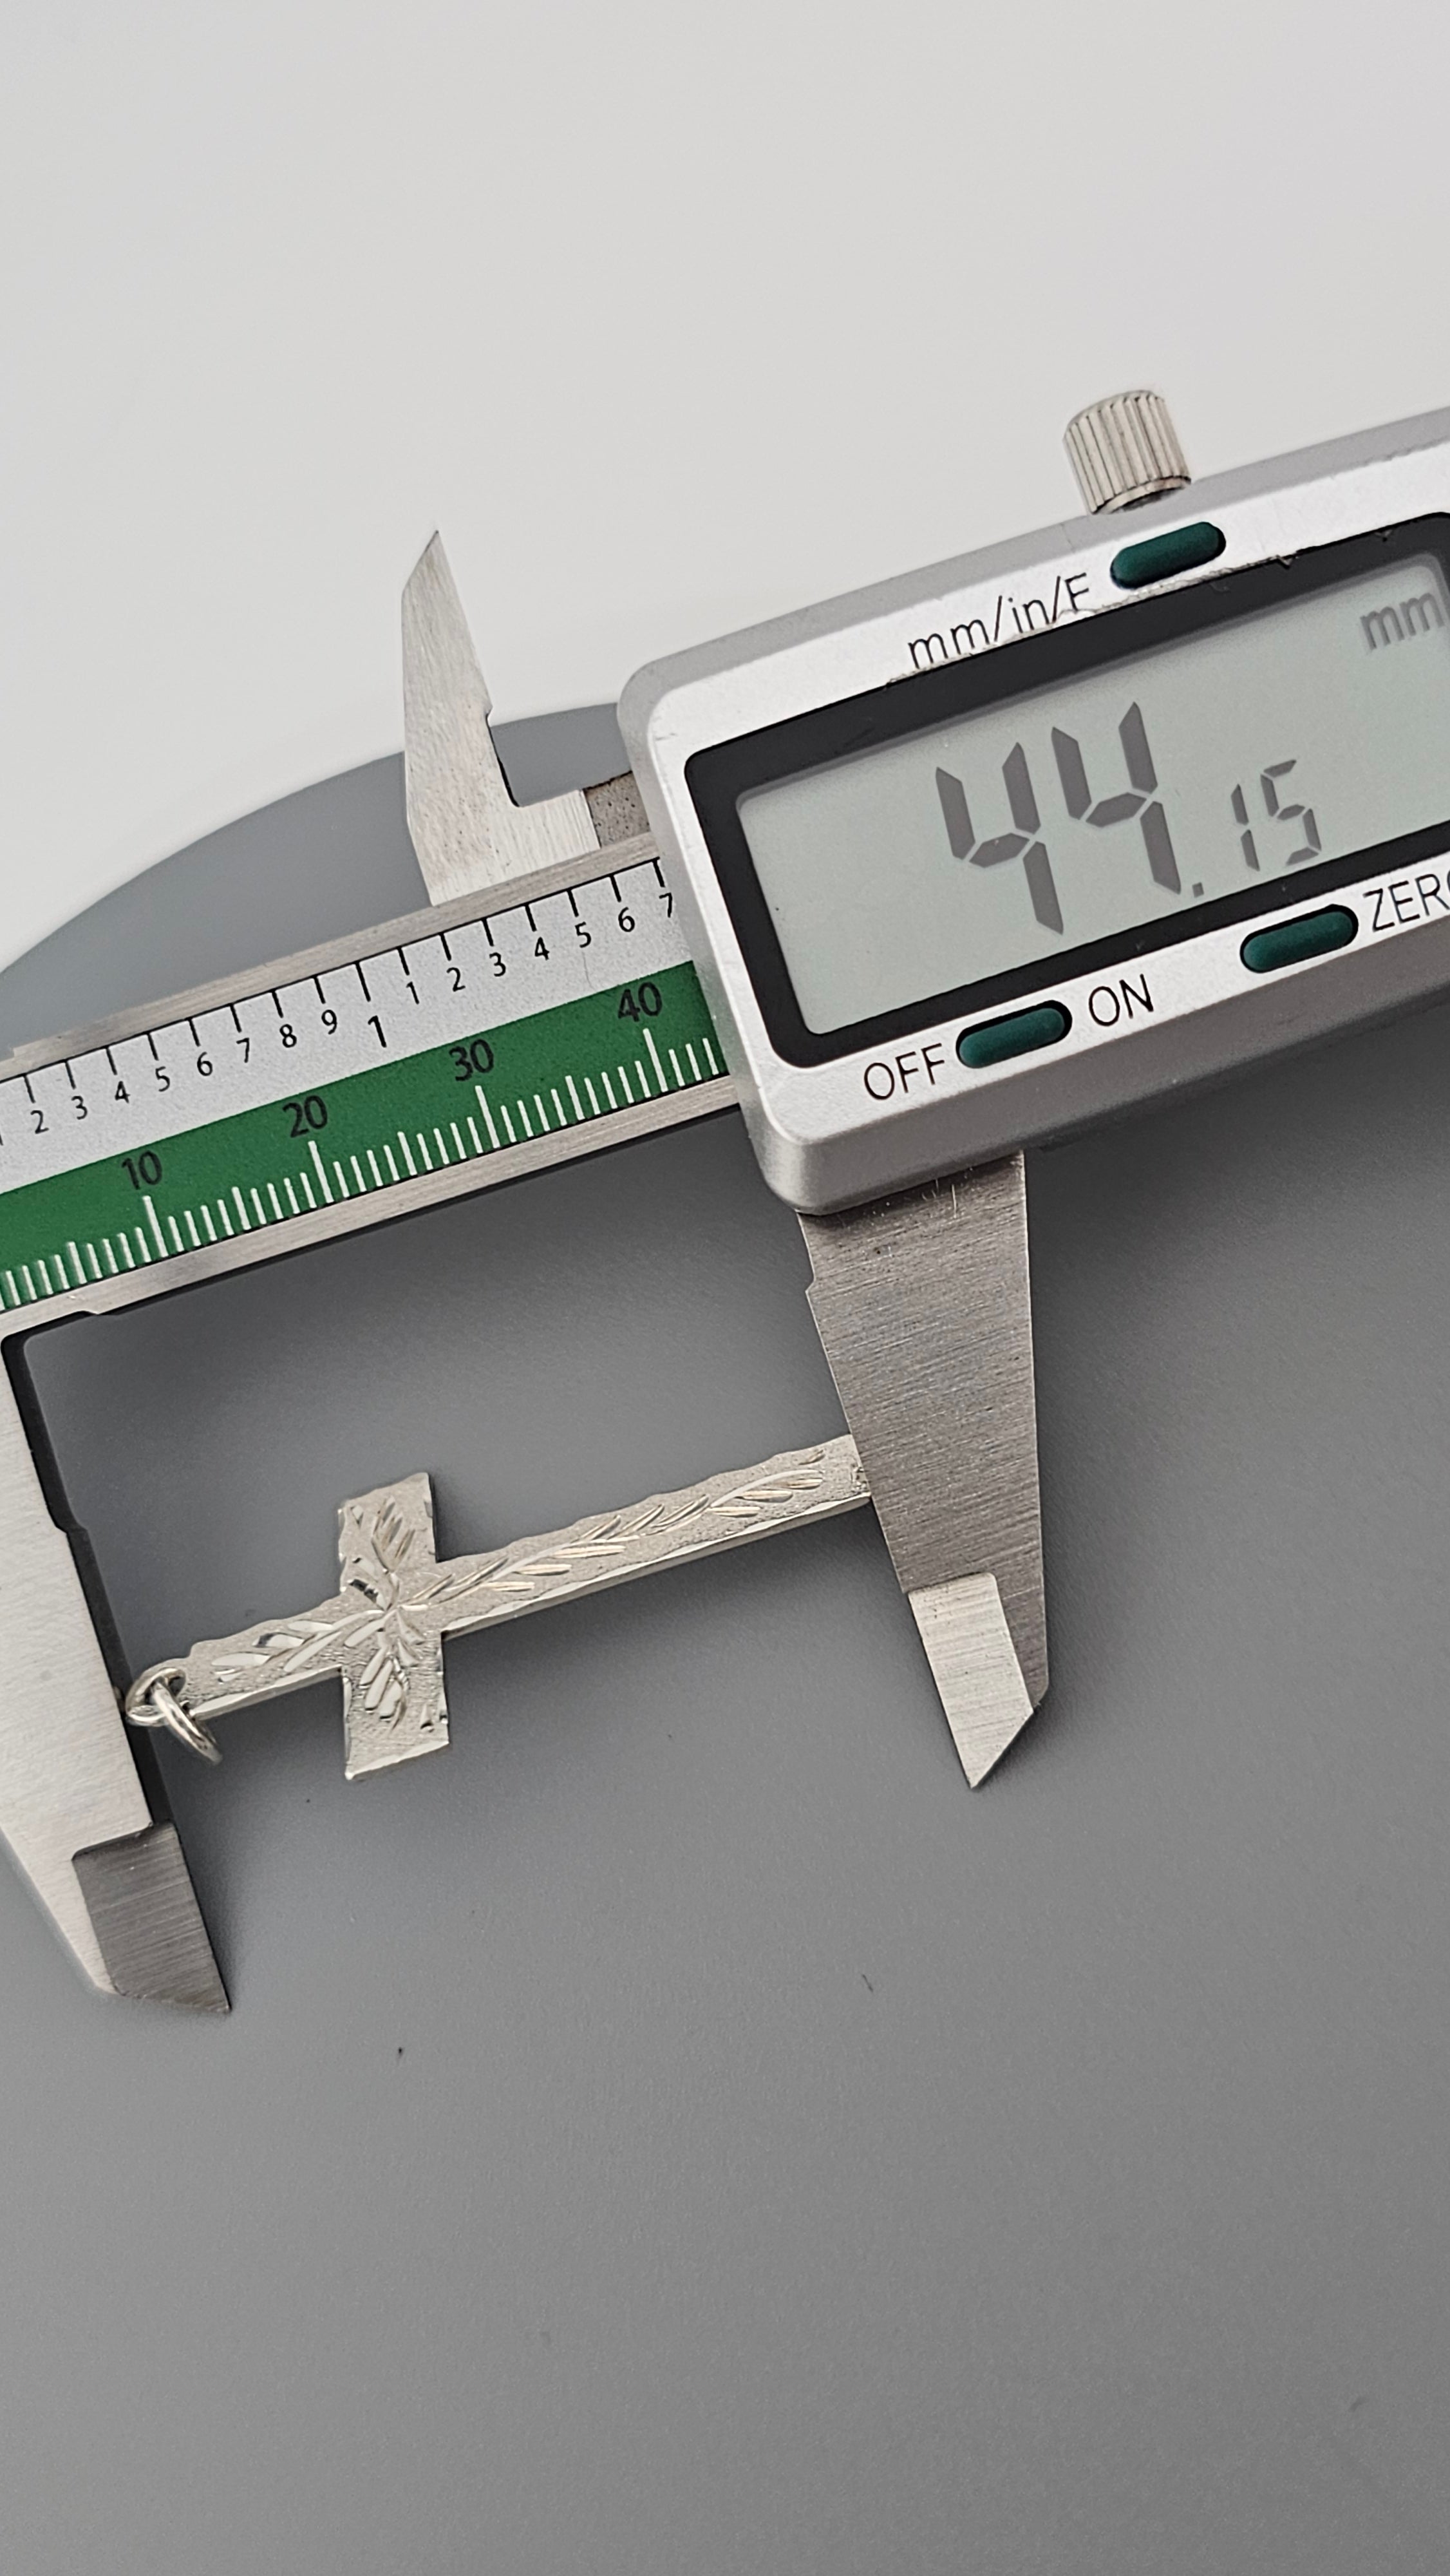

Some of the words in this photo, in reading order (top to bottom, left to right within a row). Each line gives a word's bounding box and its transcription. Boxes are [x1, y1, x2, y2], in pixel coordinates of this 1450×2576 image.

[908, 573, 1089, 670] mm/in/F
[1359, 591, 1444, 650] mm
[936, 701, 1322, 935] 44.15
[1363, 867, 1450, 931] ZER
[31, 1110, 48, 1134] 2
[72, 1097, 88, 1119] 3
[115, 1081, 131, 1104] 4
[155, 1067, 170, 1092] 5
[197, 1052, 213, 1076] 6
[236, 1038, 250, 1063] 7
[280, 1025, 297, 1048] 8
[322, 1010, 337, 1034] 9
[368, 1016, 387, 1048] 1
[406, 982, 419, 1004] 1
[446, 968, 466, 992] 2
[489, 953, 505, 976] 3
[534, 938, 549, 960] 4
[575, 923, 591, 947] 5
[618, 908, 635, 932] 6
[659, 893, 673, 918] 7
[863, 1043, 945, 1099] OFF
[1088, 974, 1154, 1026] ON
[122, 1151, 162, 1189] 10
[283, 1096, 327, 1137] 20
[449, 1039, 494, 1081] 30
[618, 982, 662, 1022] 40
